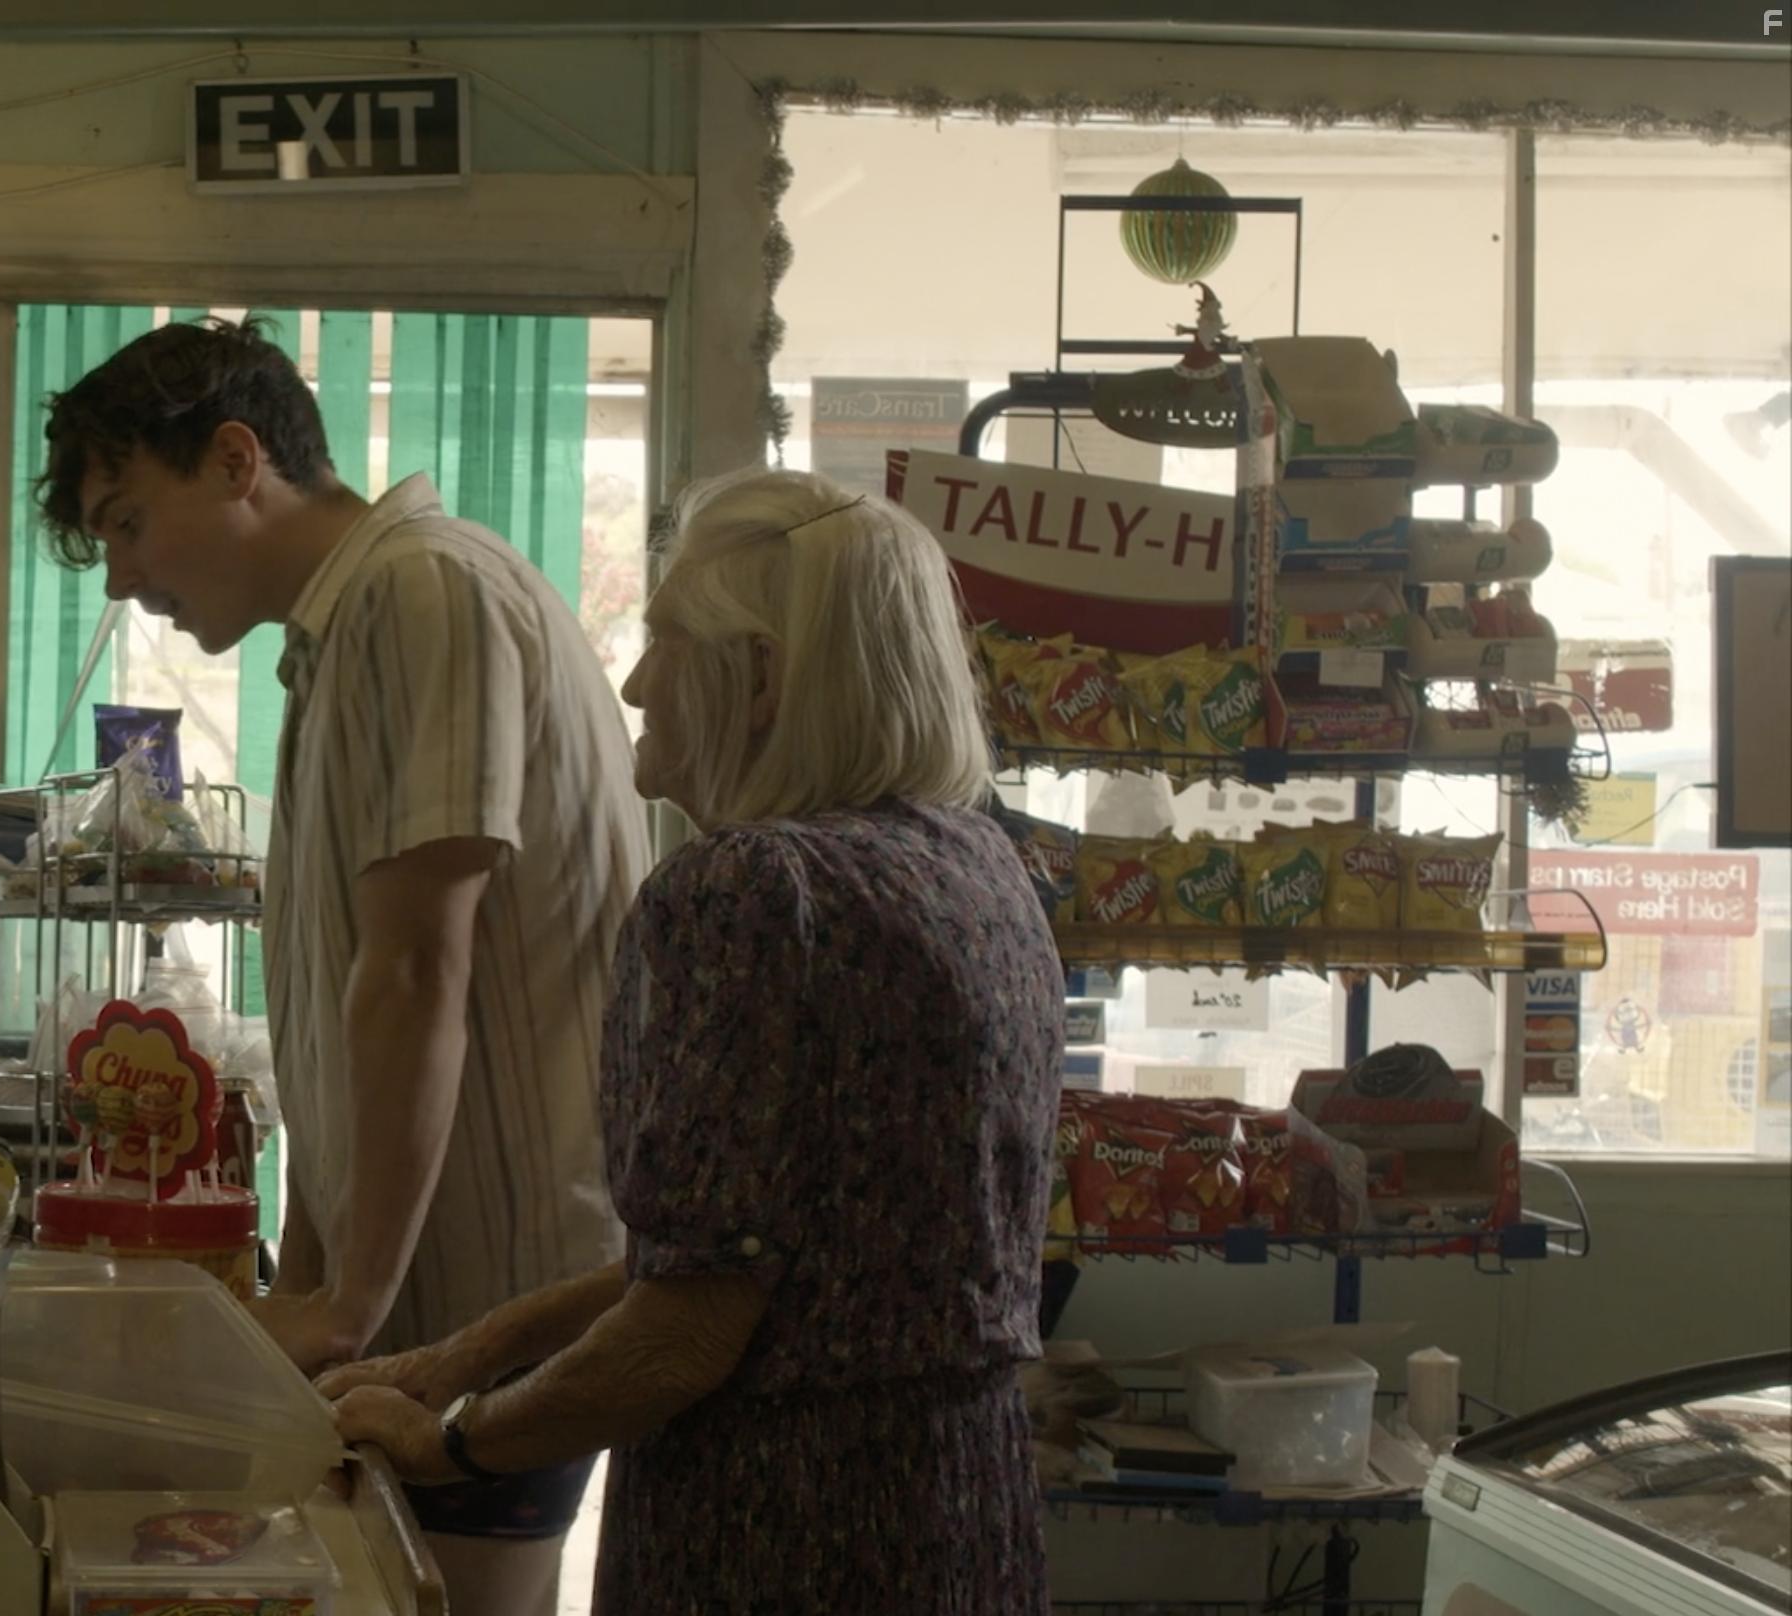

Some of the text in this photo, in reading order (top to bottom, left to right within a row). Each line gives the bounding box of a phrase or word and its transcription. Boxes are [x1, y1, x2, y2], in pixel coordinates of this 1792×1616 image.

[219, 90, 435, 171] EXIT
[934, 475, 1225, 573] TALLY-H
[1049, 675, 1107, 726] Twisti
[1201, 678, 1263, 730] Twistie
[1092, 872, 1155, 923] Twistie
[1527, 977, 1577, 996] VISA
[96, 1053, 189, 1101] Chupa
[1094, 1139, 1165, 1171] Doritos
